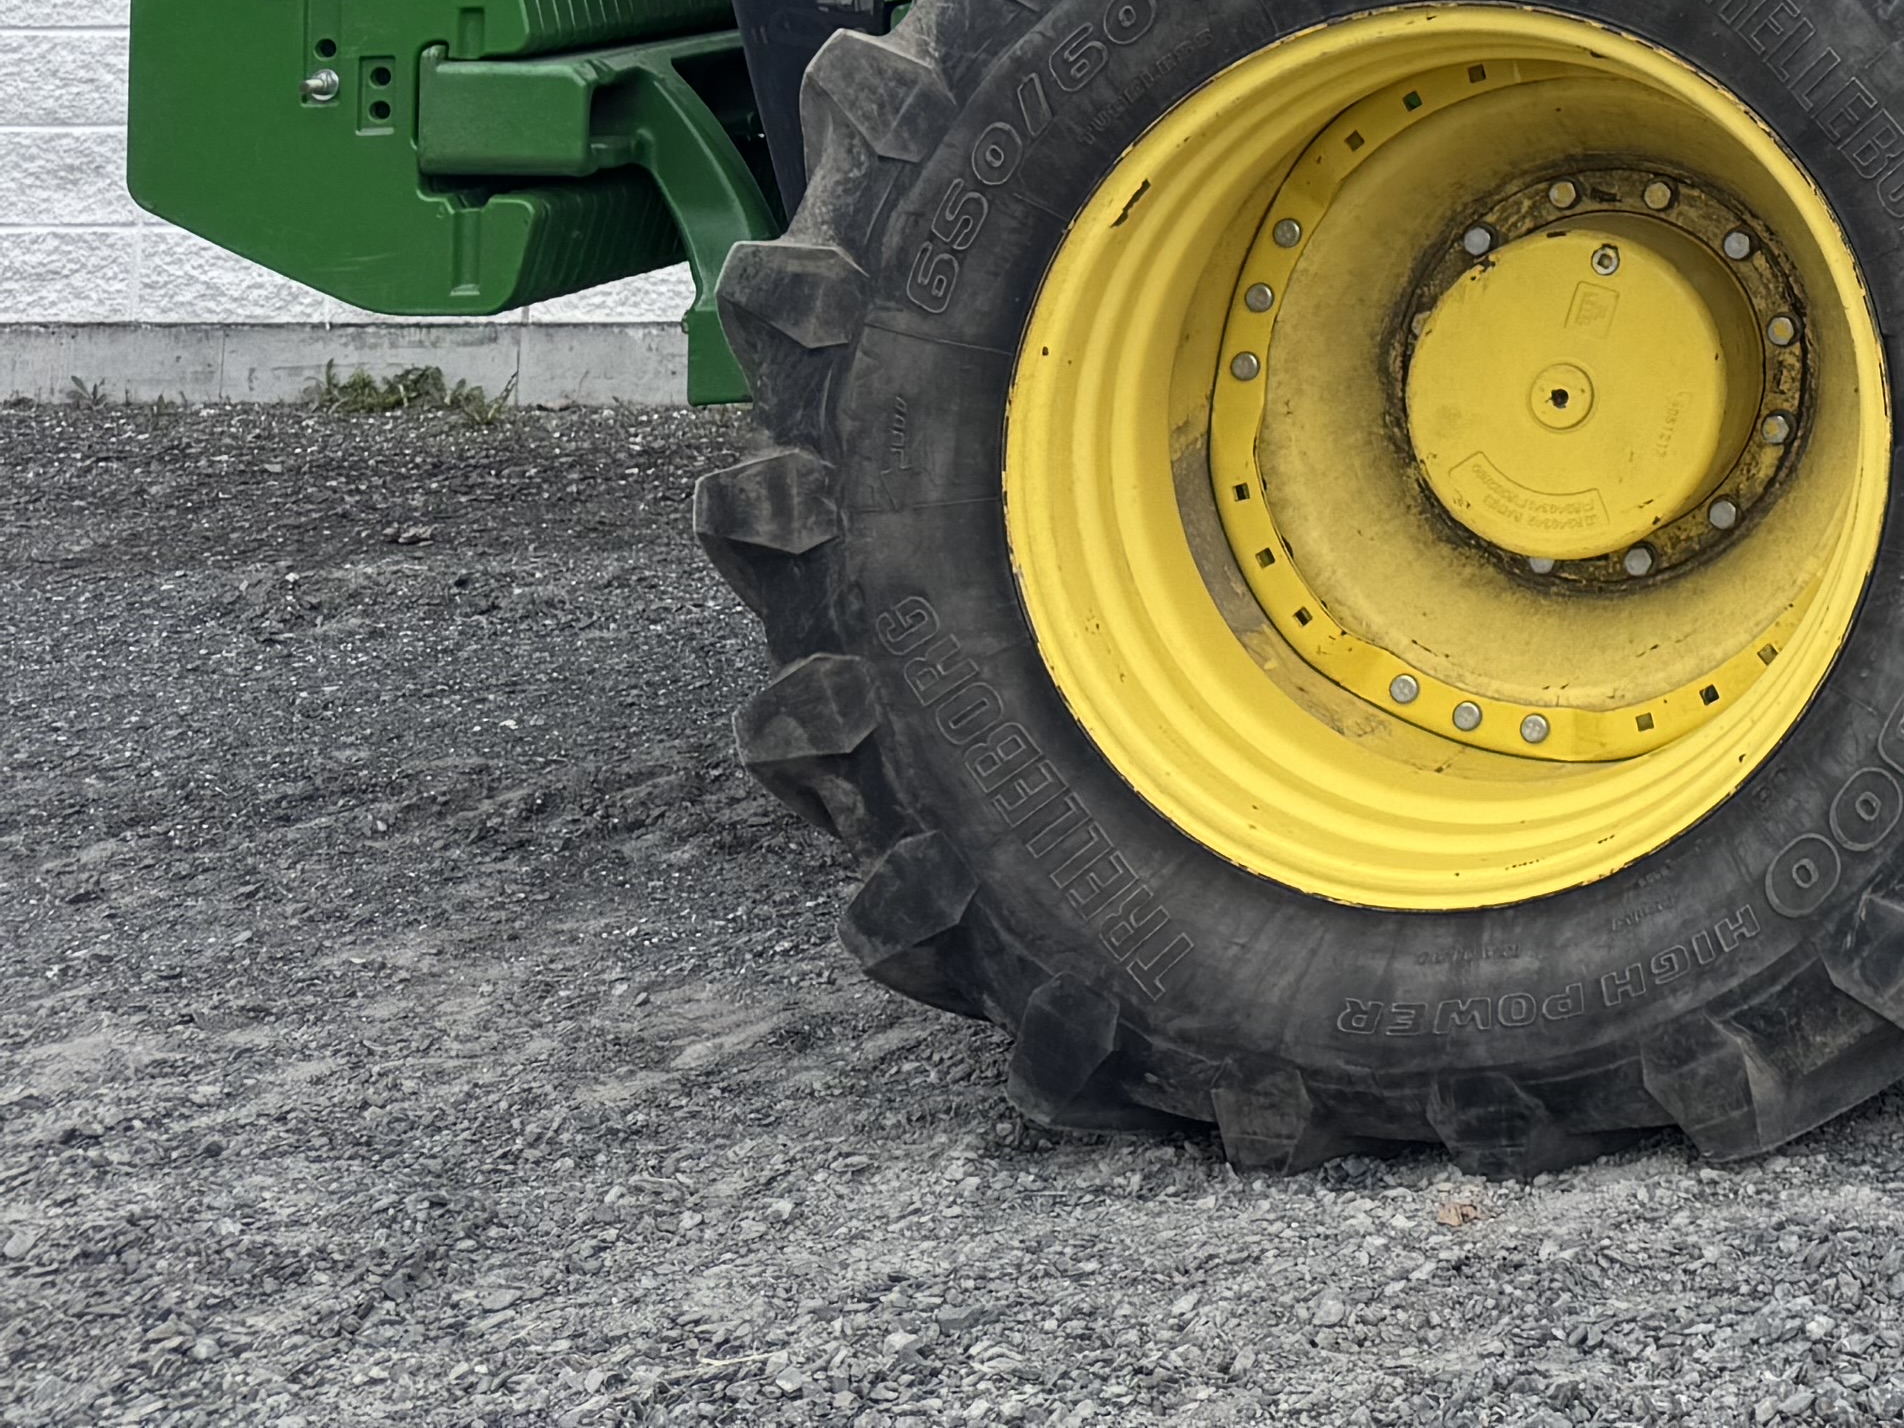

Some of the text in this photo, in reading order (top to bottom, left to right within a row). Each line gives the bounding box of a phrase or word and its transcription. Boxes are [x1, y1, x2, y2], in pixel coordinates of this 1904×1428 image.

[876, 595, 1196, 1002] TRELLEBORG
[1601, 903, 1761, 1008] HIGH
[1336, 981, 1585, 1038] POWER
